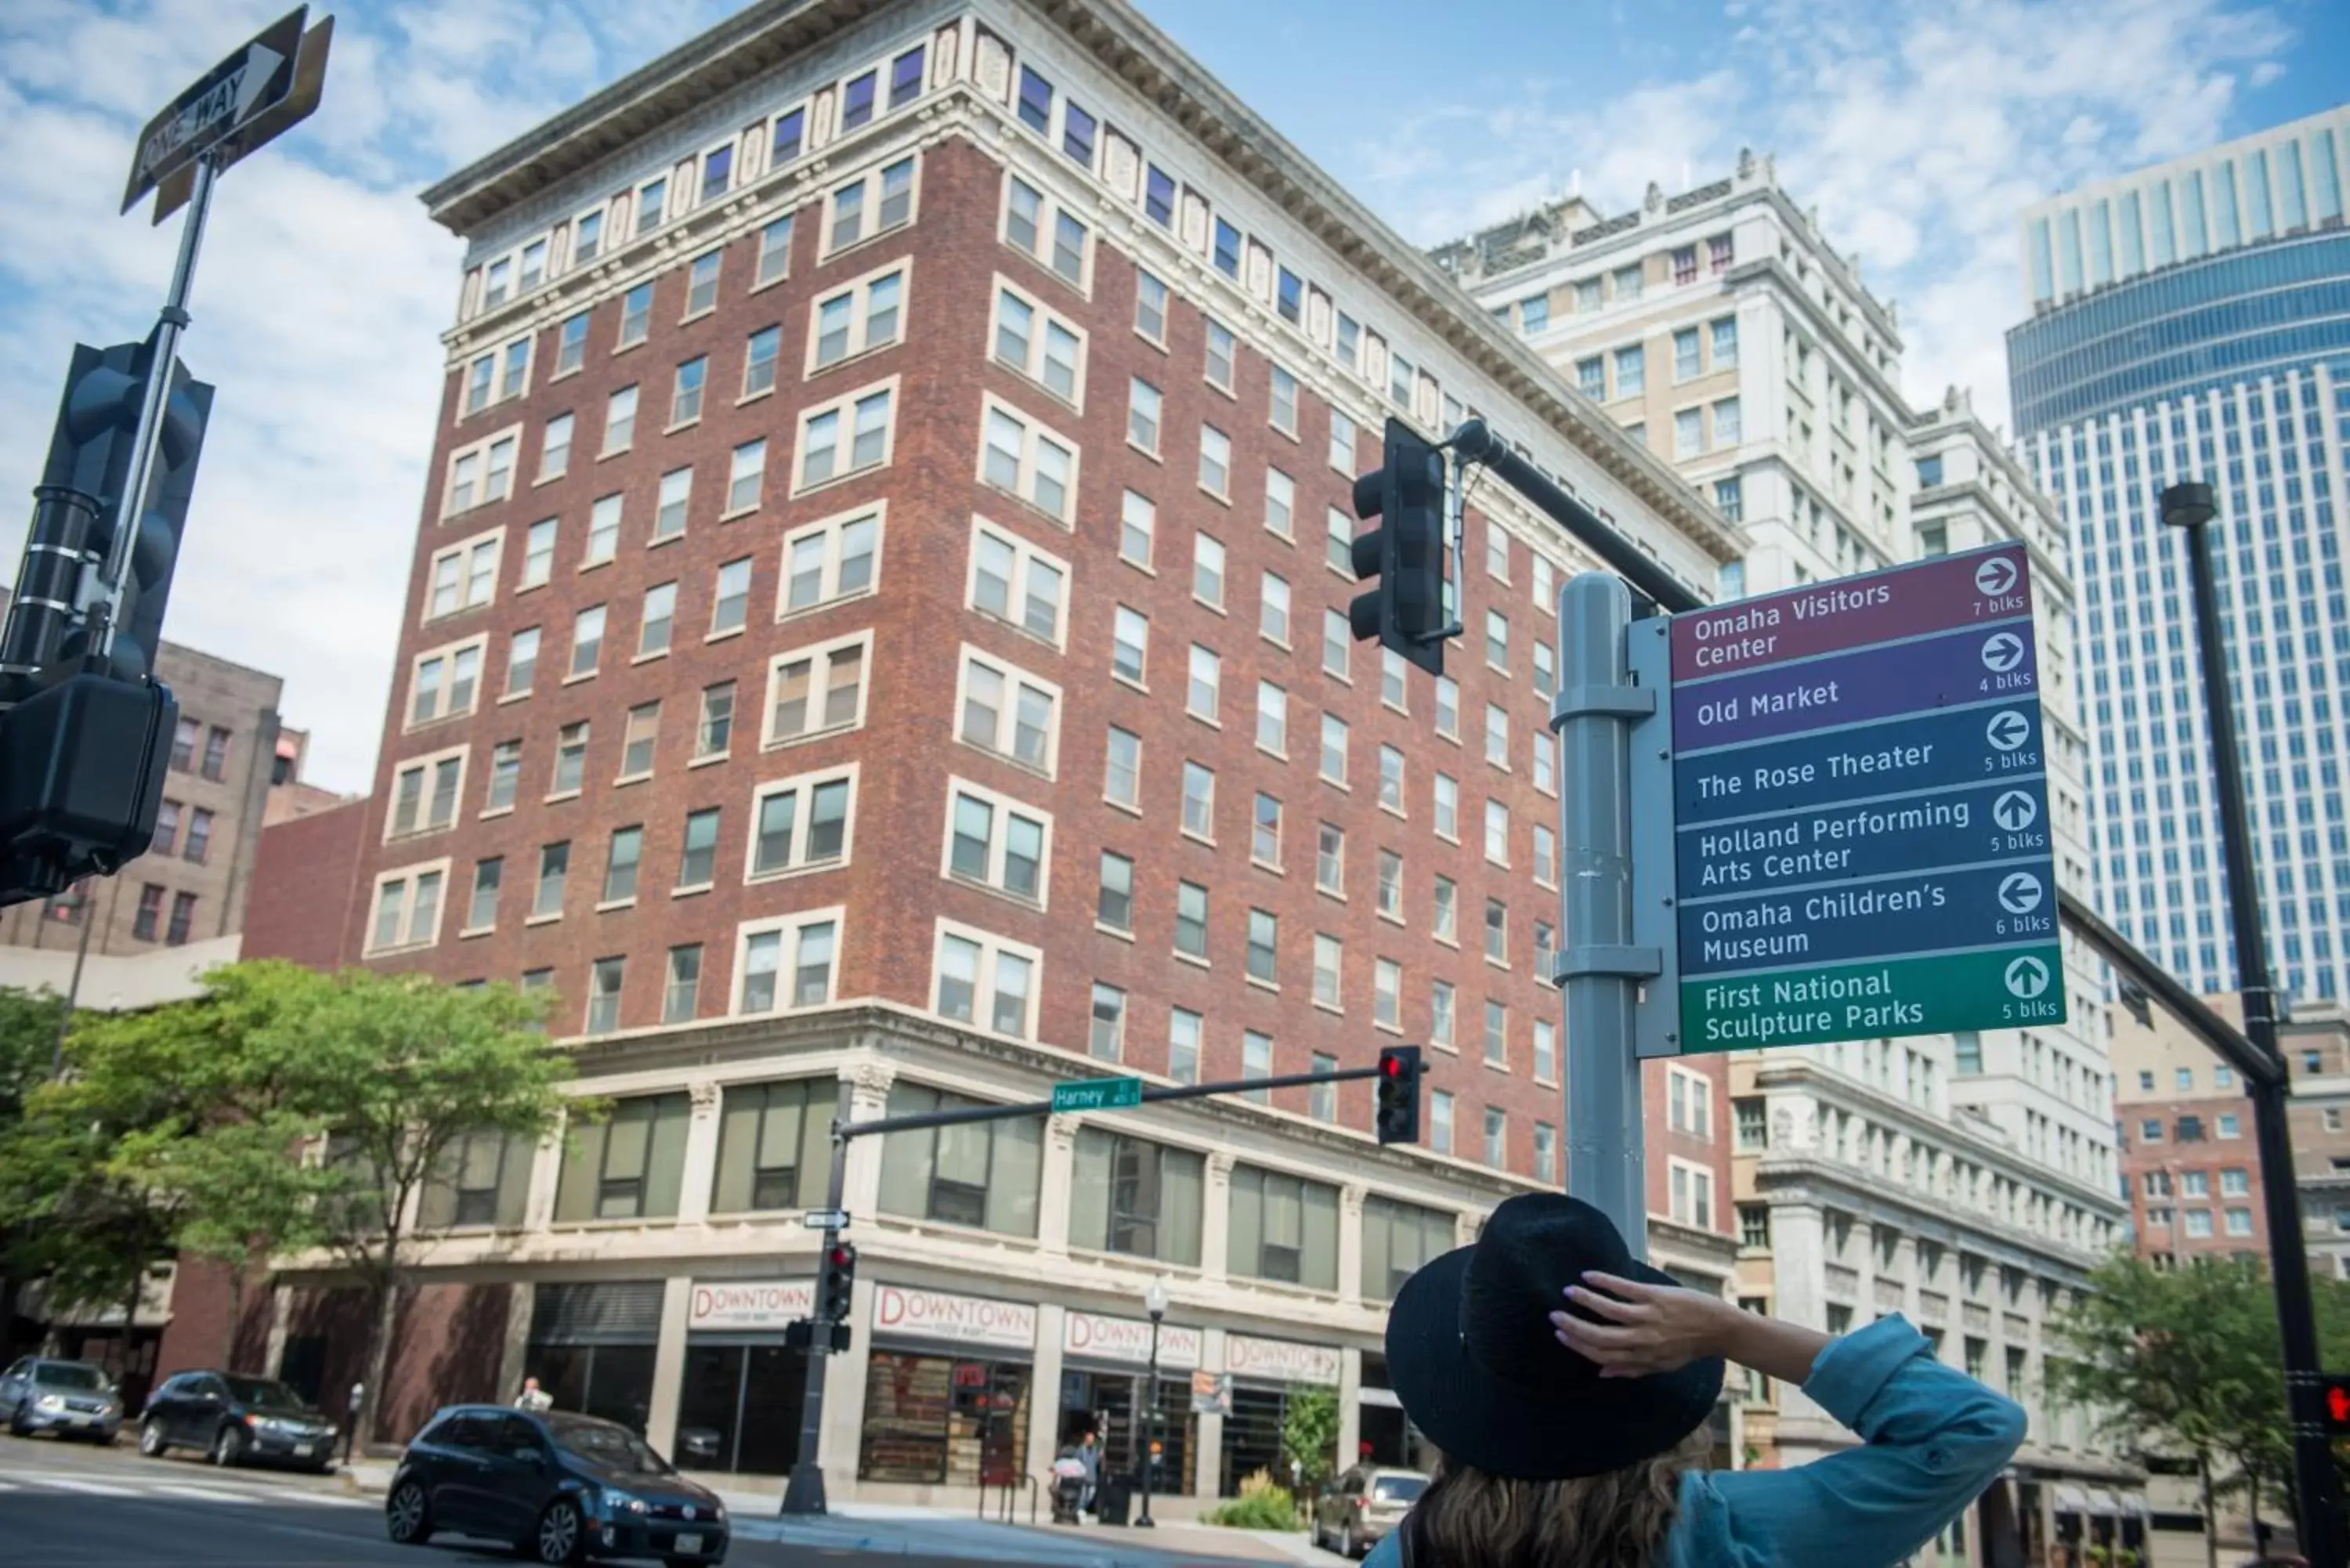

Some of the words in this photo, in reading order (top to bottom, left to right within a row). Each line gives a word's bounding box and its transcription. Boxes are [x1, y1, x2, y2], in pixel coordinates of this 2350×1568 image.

[193, 67, 248, 132] WAY
[1696, 609, 1780, 640] Omaha
[1792, 584, 1889, 620] Visitors
[1974, 602, 1980, 616] 7
[1990, 596, 2023, 612] blks
[1696, 634, 1777, 667] Center
[1980, 679, 1987, 692] 4
[1997, 670, 2030, 688] blks
[1698, 699, 1737, 725] Old
[1752, 681, 1838, 715] Market
[1698, 775, 1741, 798] The
[1755, 764, 1814, 789] Rose
[1828, 744, 1932, 777] Theater
[1985, 757, 1993, 771] 5
[2001, 752, 2036, 768] blks
[1701, 822, 1799, 857] Holland
[1813, 801, 1969, 841] Performing
[1992, 837, 1999, 851] 5
[2008, 833, 2043, 849] blks
[1702, 861, 1751, 885] Arts
[1764, 846, 1850, 876] Center
[1703, 904, 1791, 932] Omaha
[1806, 883, 1944, 919] Children's
[1997, 919, 2005, 934] 6
[2014, 916, 2049, 932] blks
[1705, 930, 1808, 961] Museum
[1706, 984, 1760, 1010] First
[1775, 970, 1891, 1003] National
[1707, 1003, 1831, 1041] Sculpture
[1847, 1000, 1922, 1028] Parks
[2003, 1005, 2012, 1018] 5
[2020, 999, 2056, 1017] blks
[1057, 1089, 1104, 1107] Harney
[695, 1288, 810, 1317] DOWNTOWN
[880, 1288, 1030, 1329] DOWNTOWN
